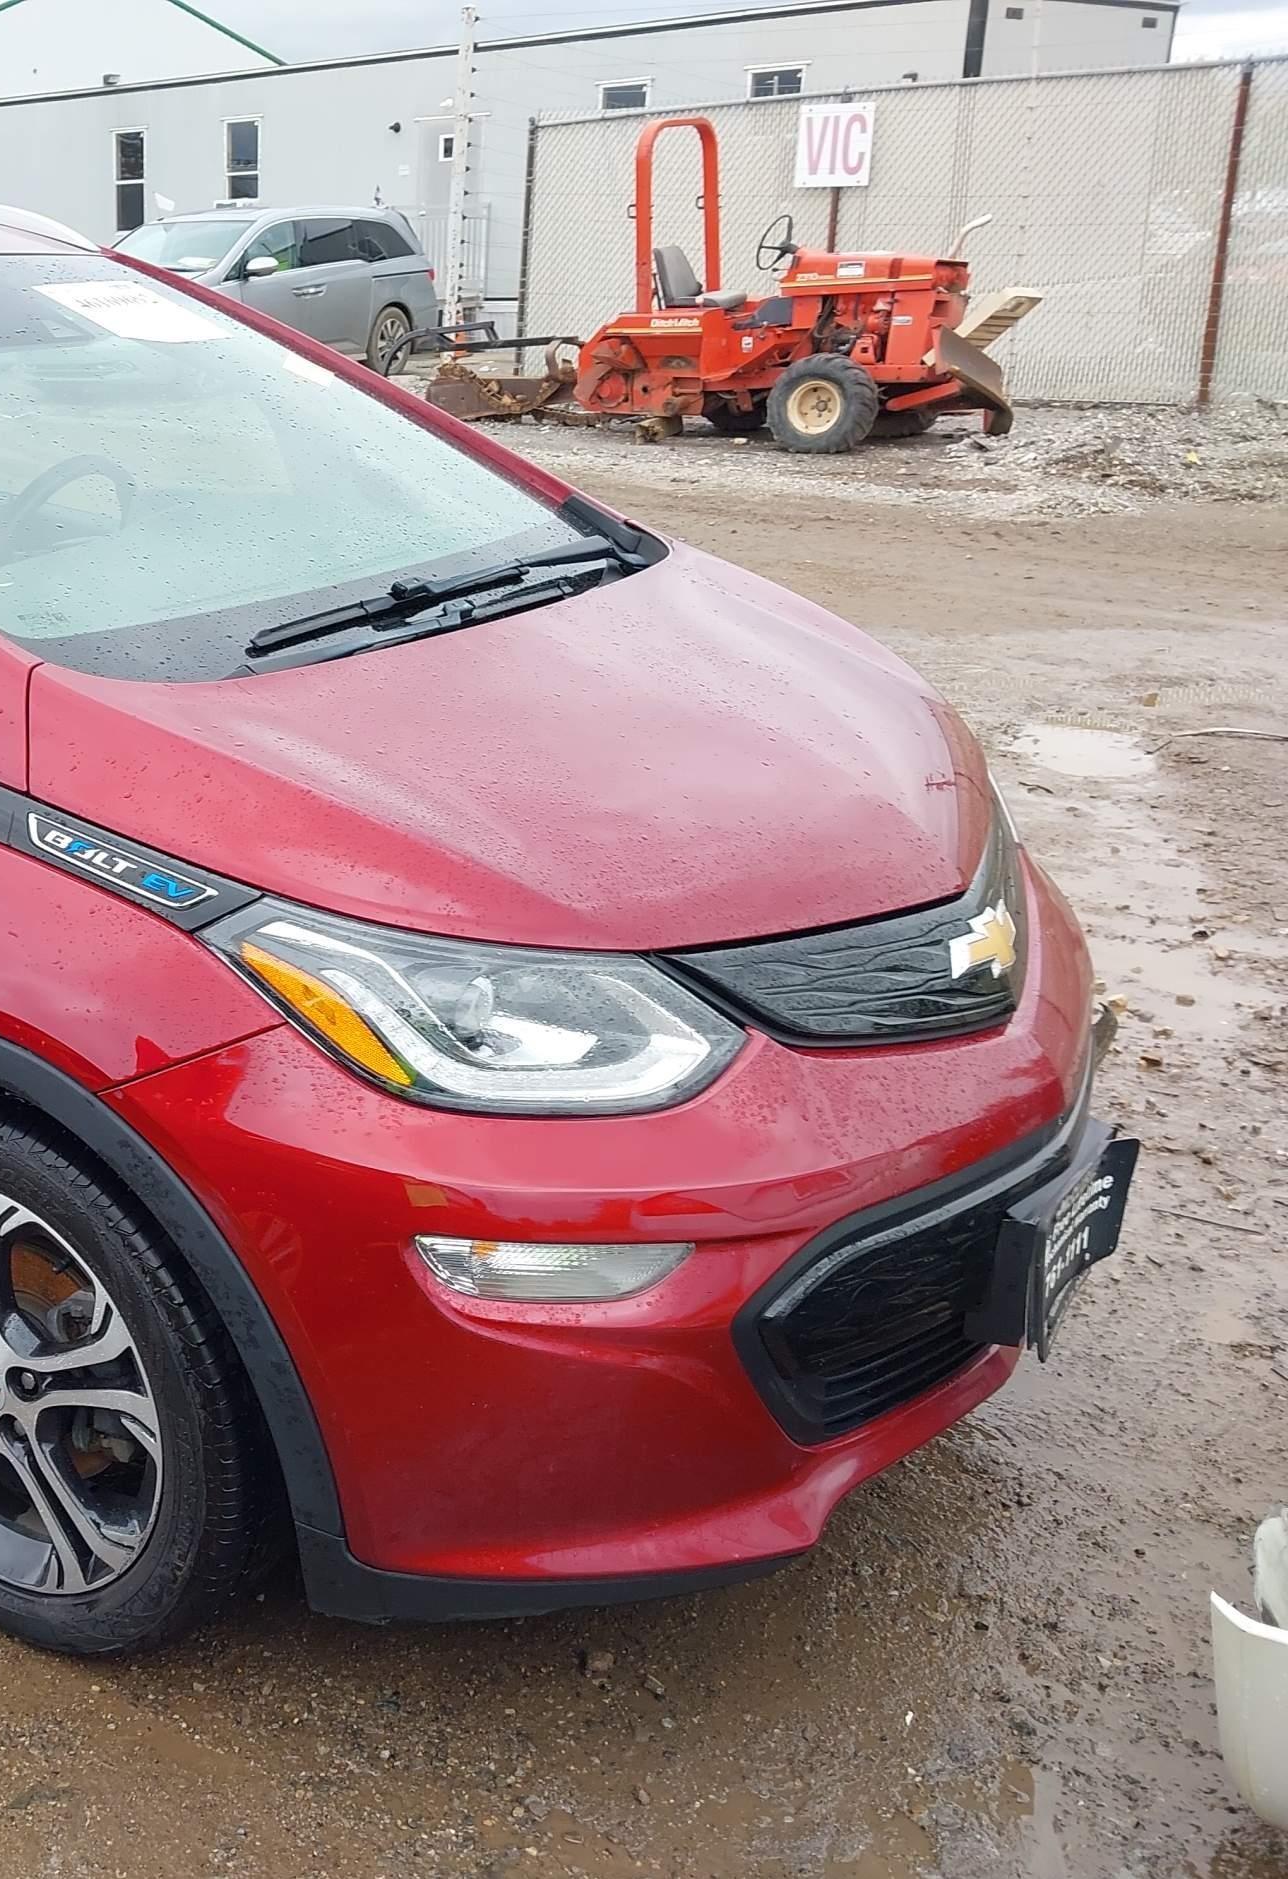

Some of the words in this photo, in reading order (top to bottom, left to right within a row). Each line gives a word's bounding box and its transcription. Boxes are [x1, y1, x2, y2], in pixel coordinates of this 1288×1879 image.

[806, 113, 867, 175] VIC
[43, 829, 138, 874] BOLT
[141, 873, 194, 898] EV
